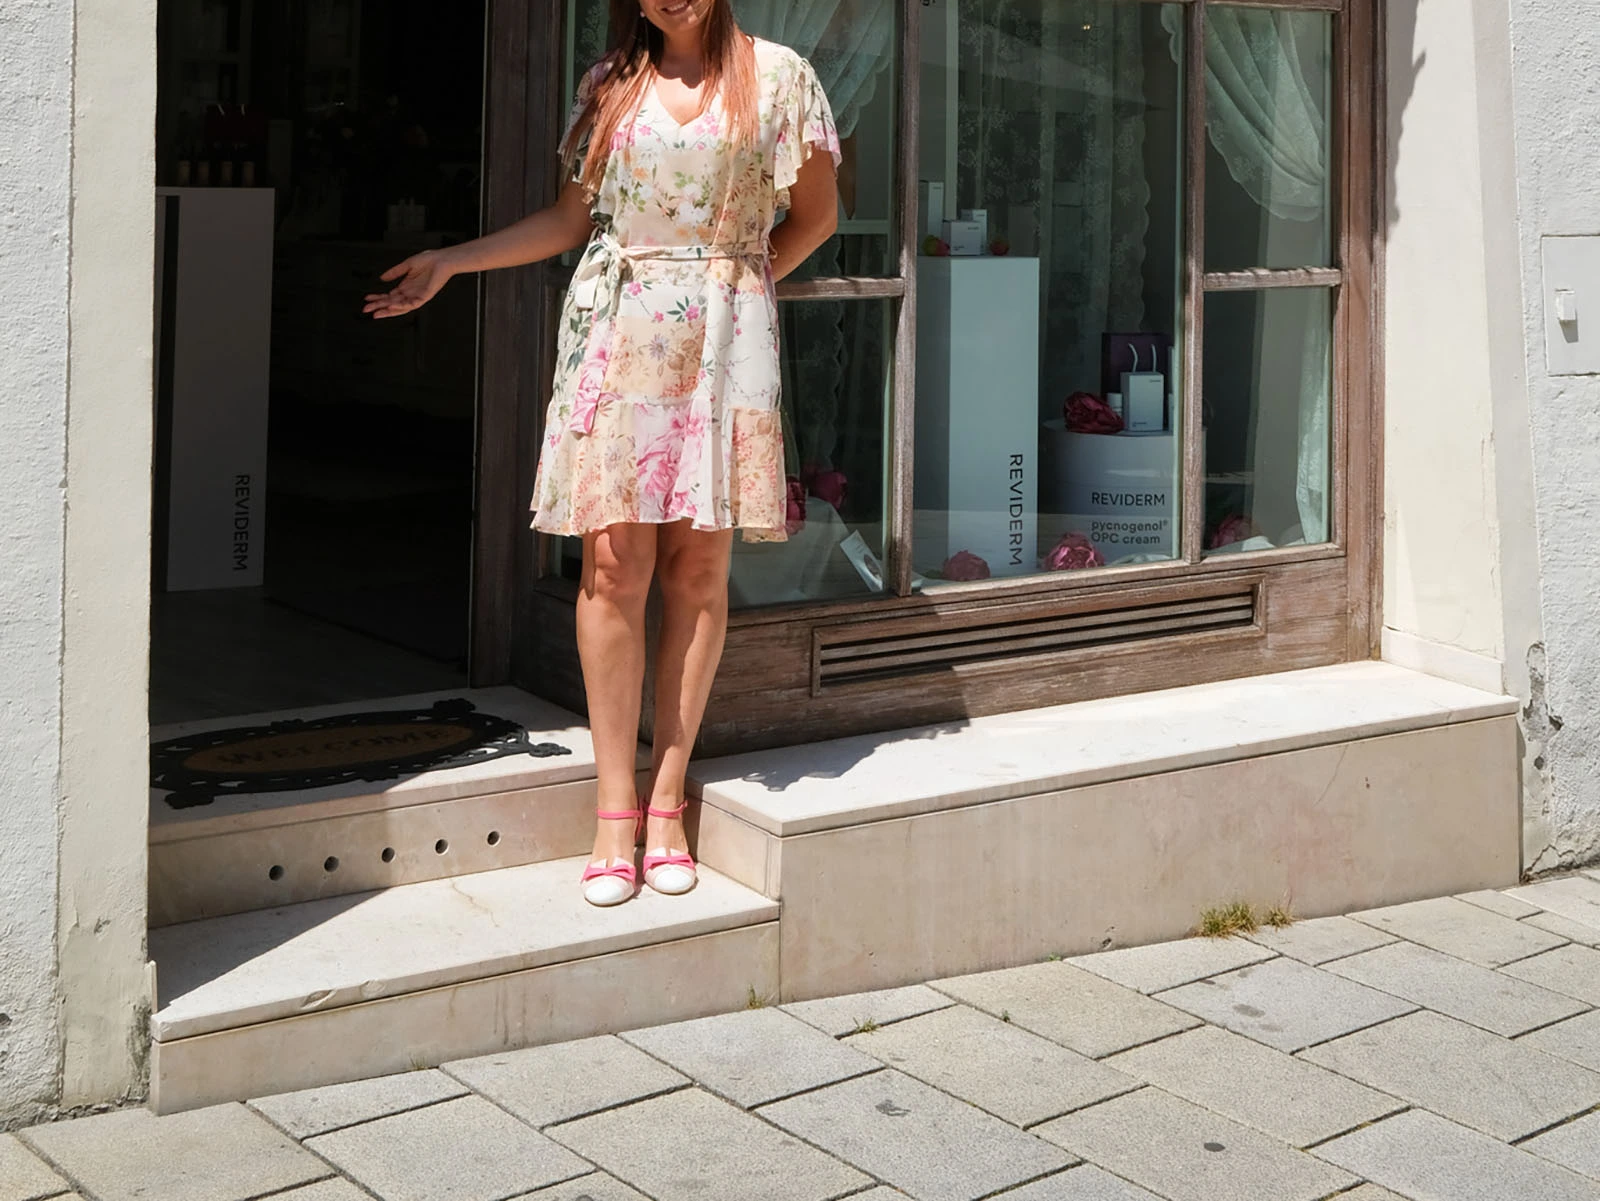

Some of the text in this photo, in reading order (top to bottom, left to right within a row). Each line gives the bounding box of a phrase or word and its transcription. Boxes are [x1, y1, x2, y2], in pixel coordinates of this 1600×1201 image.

[232, 474, 251, 571] REVIDERM
[1009, 453, 1024, 566] REVIDERM
[1091, 491, 1166, 507] REVIDERM
[1091, 531, 1161, 545] OPC cream
